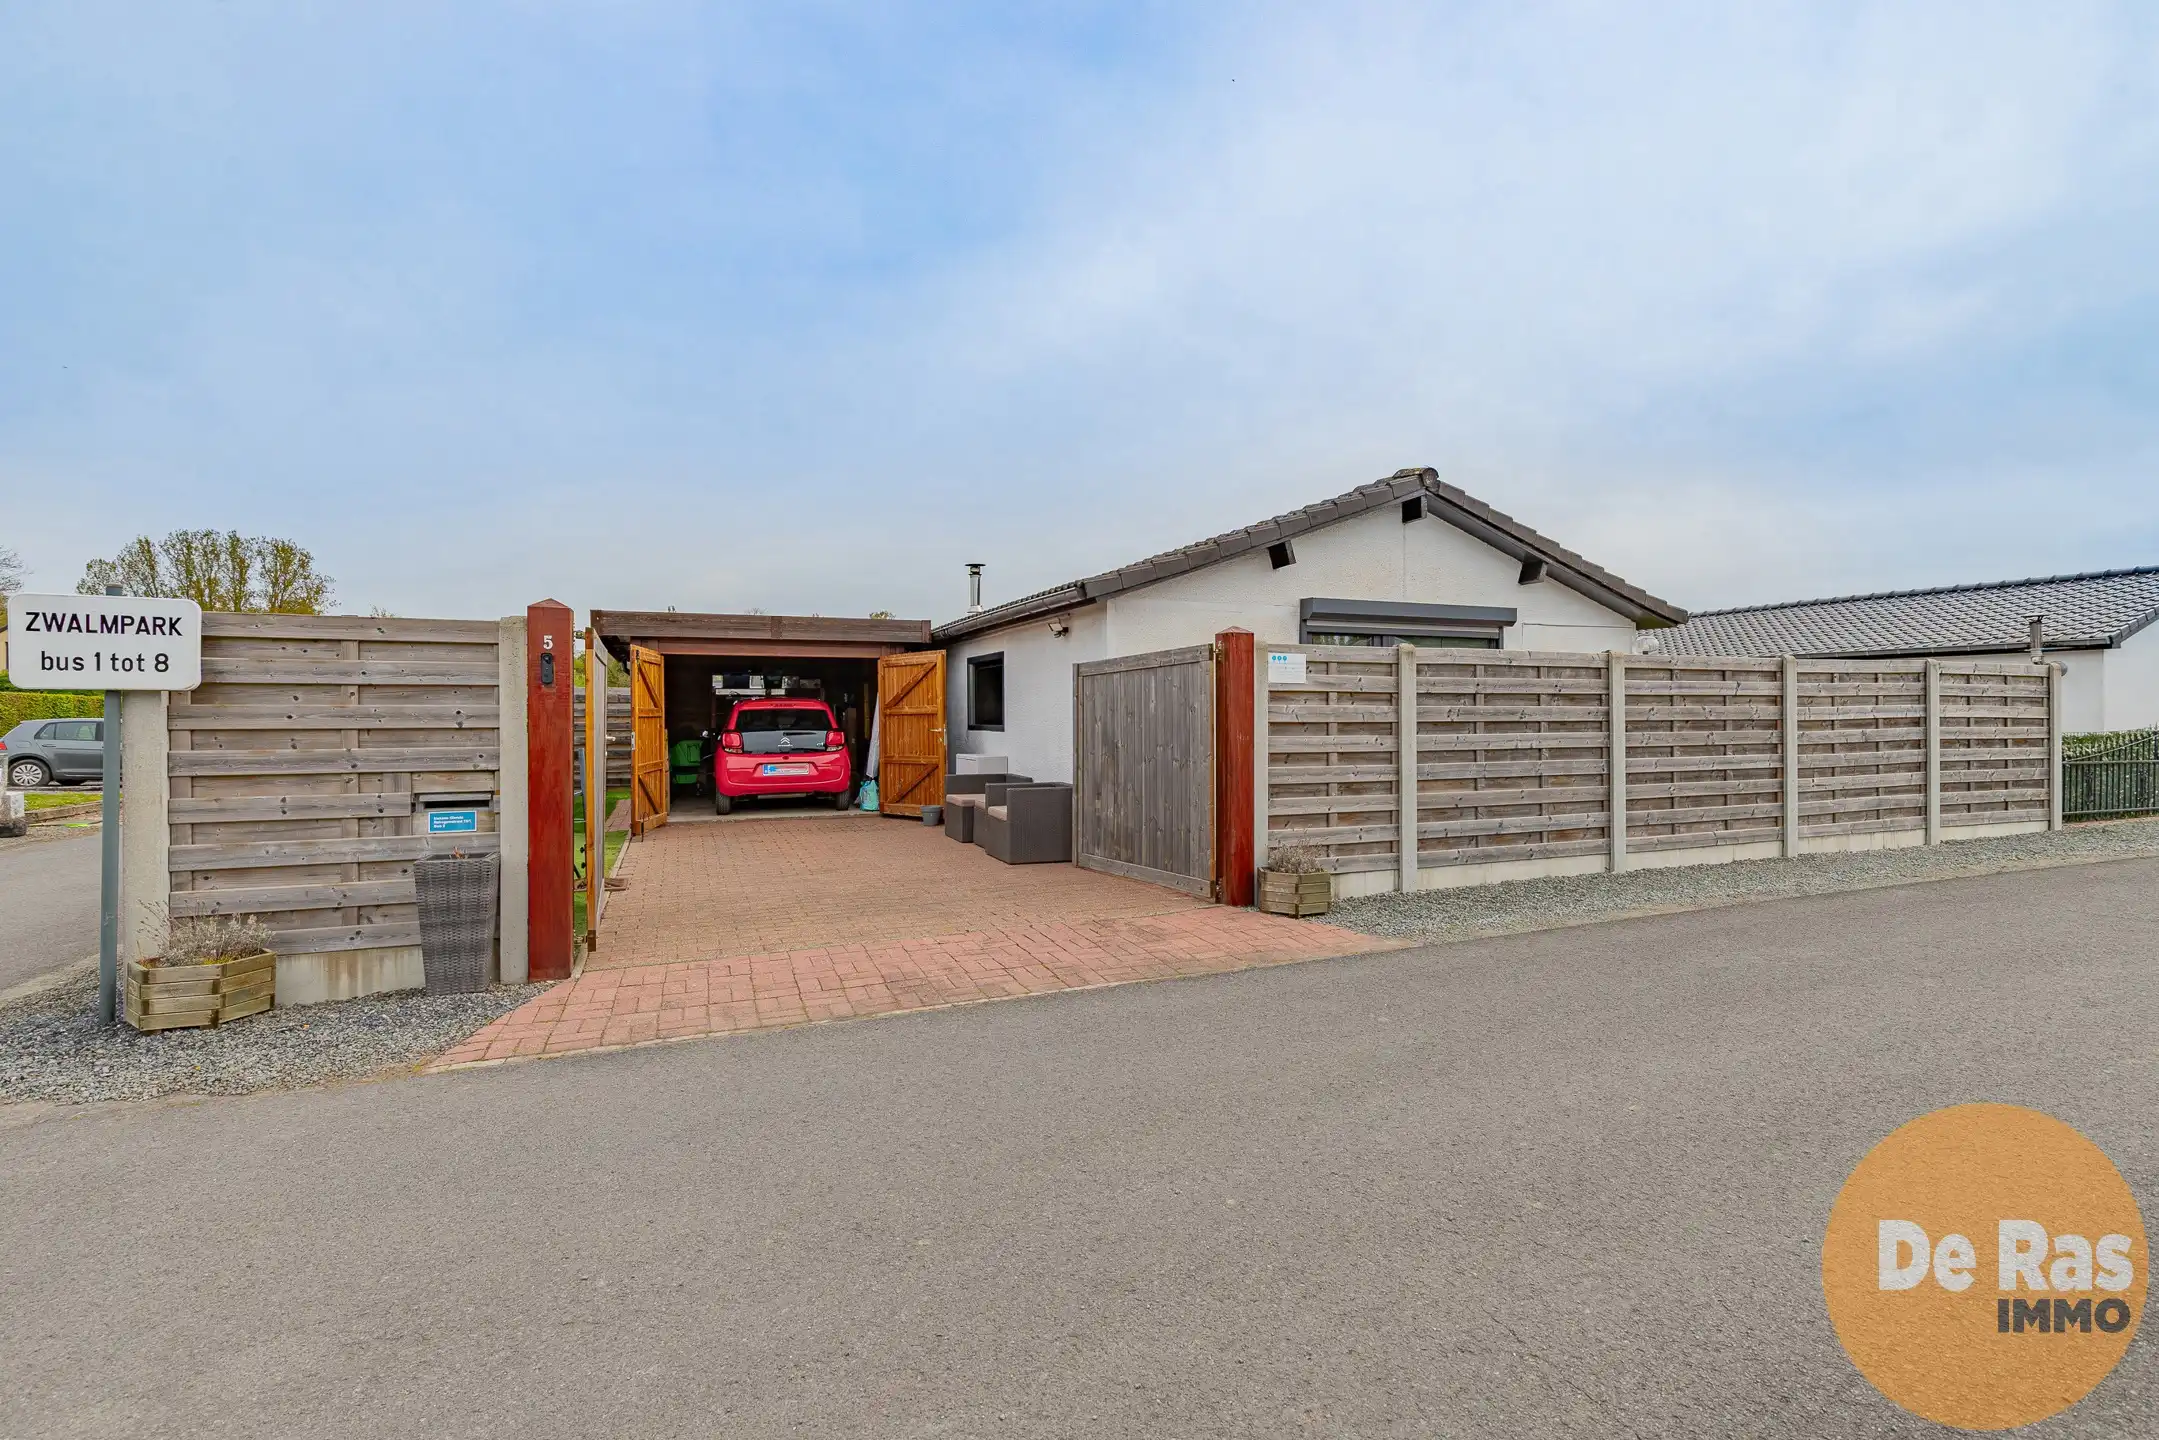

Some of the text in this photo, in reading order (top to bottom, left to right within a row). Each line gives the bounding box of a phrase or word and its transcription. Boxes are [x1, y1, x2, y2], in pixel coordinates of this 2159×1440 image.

[25, 611, 183, 637] ZWALMPARK
[543, 634, 554, 650] 5
[41, 650, 170, 673] bus 1 tot 8
